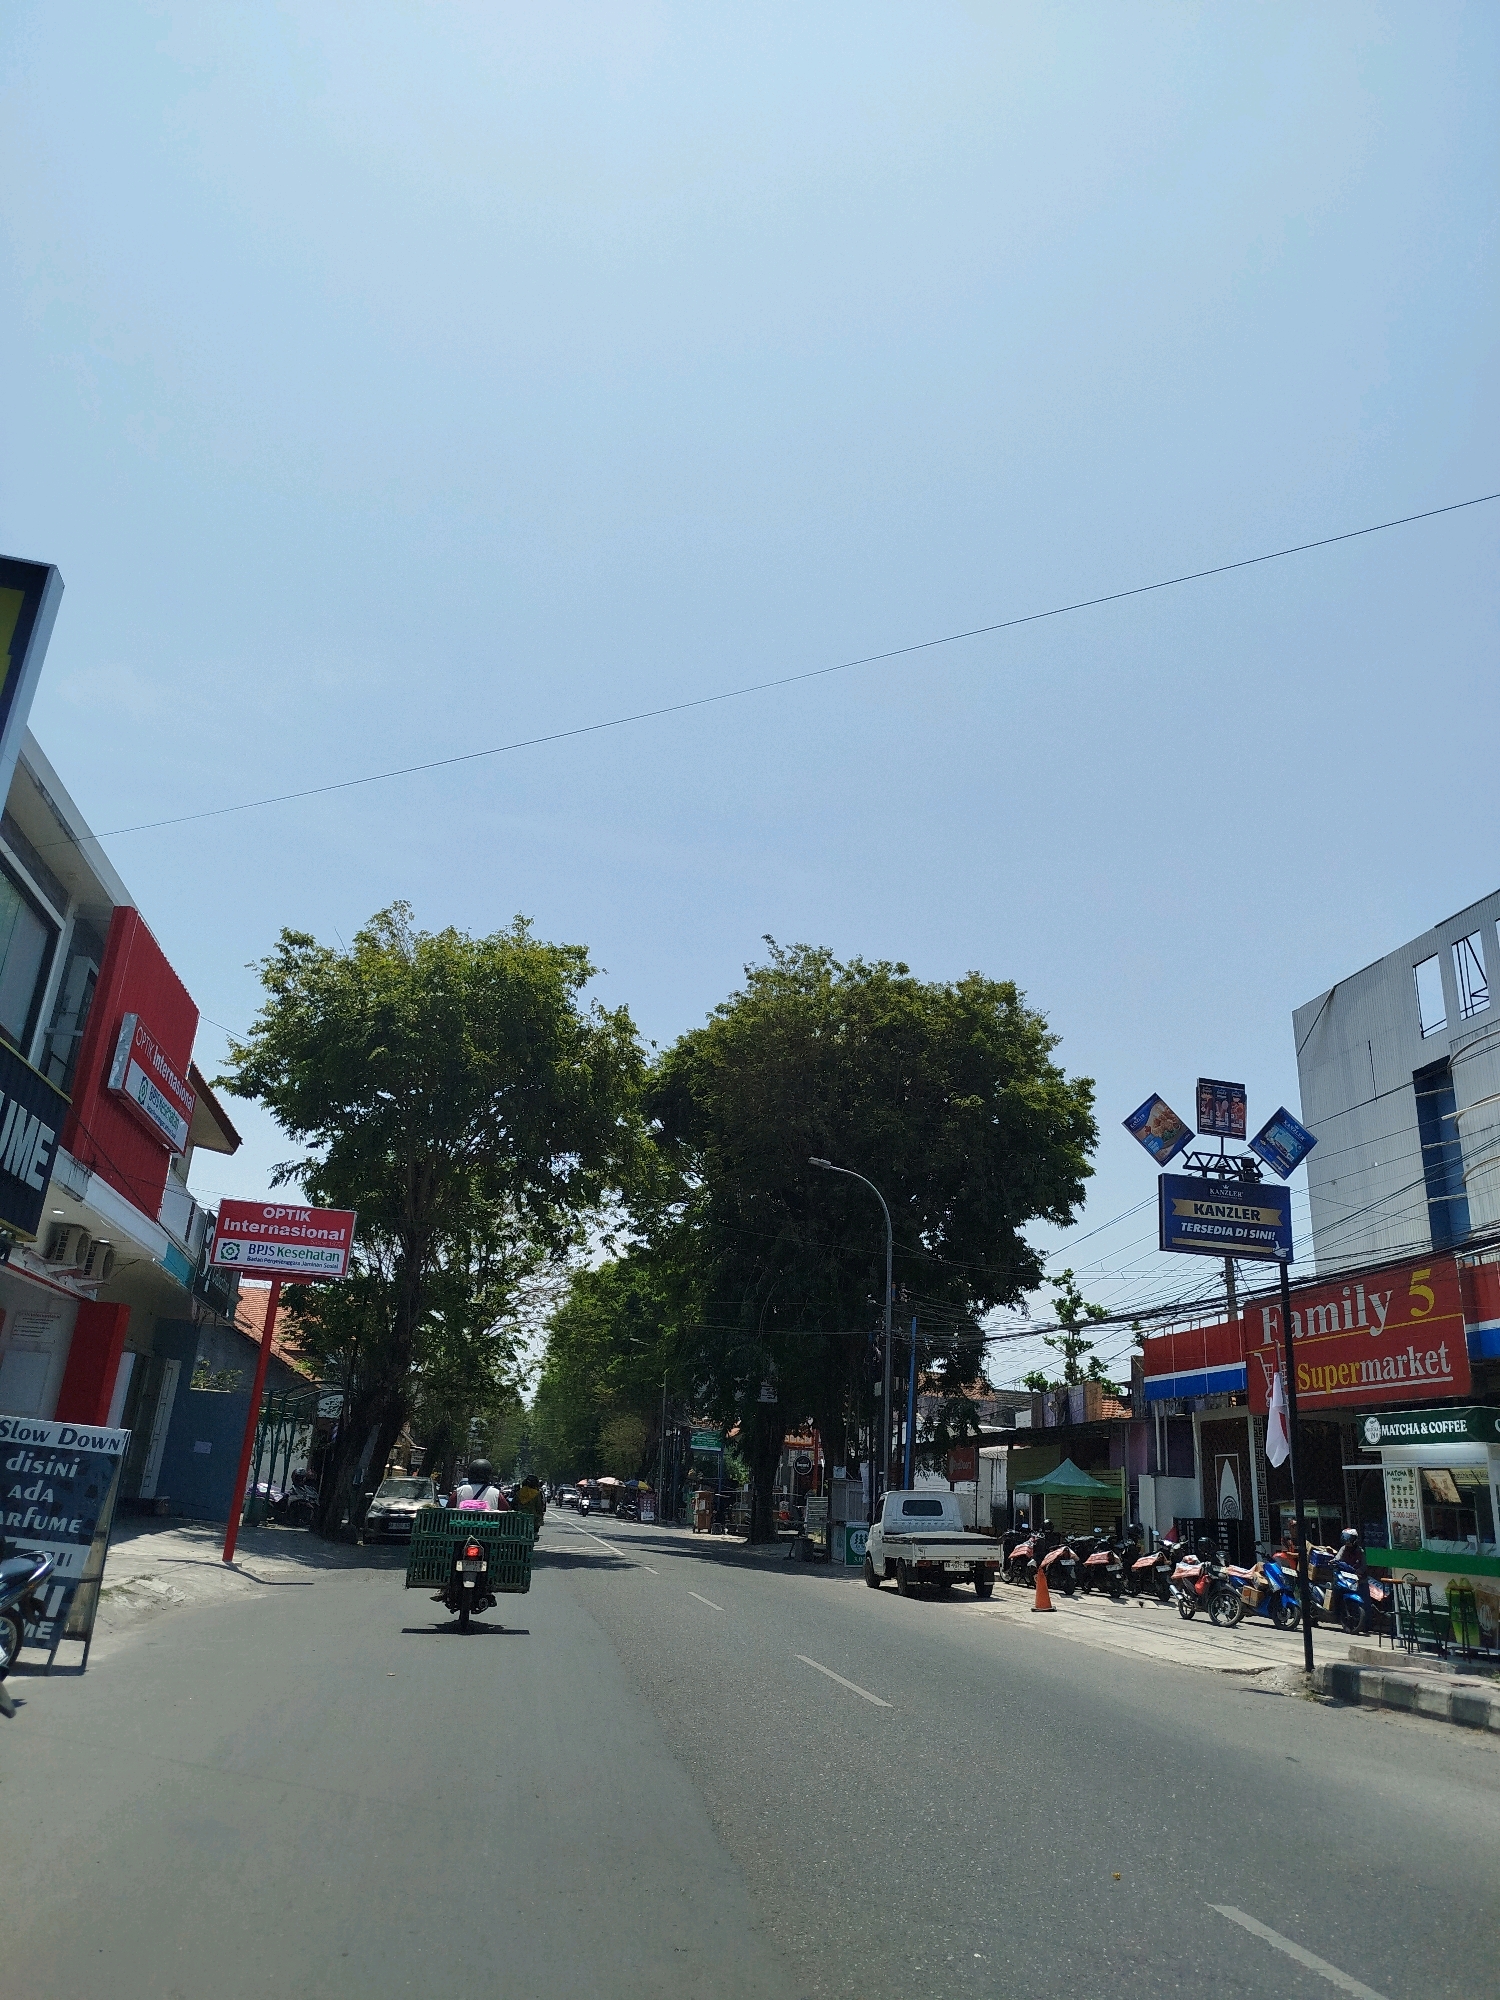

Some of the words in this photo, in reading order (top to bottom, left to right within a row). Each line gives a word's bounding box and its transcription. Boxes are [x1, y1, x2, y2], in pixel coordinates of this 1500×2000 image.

[153, 1045, 195, 1114] Internasional
[1210, 1188, 1243, 1198] KANZLER
[263, 1206, 312, 1222] OPTIK
[1194, 1203, 1260, 1221] KANZLER
[223, 1217, 345, 1241] Internasional
[1181, 1222, 1233, 1237] TERSEDIA
[1234, 1227, 1248, 1238] DI
[1249, 1231, 1276, 1240] SINI!
[248, 1243, 276, 1257] BPJS
[276, 1246, 340, 1262] Kesehatan
[1261, 1283, 1393, 1346] Family
[1409, 1267, 1435, 1317] 5
[1297, 1340, 1451, 1394] Supermarket
[0, 1420, 51, 1443] Slow
[1381, 1421, 1420, 1437] MATCHA
[1420, 1422, 1428, 1435] &
[1428, 1419, 1468, 1434] COFFEE
